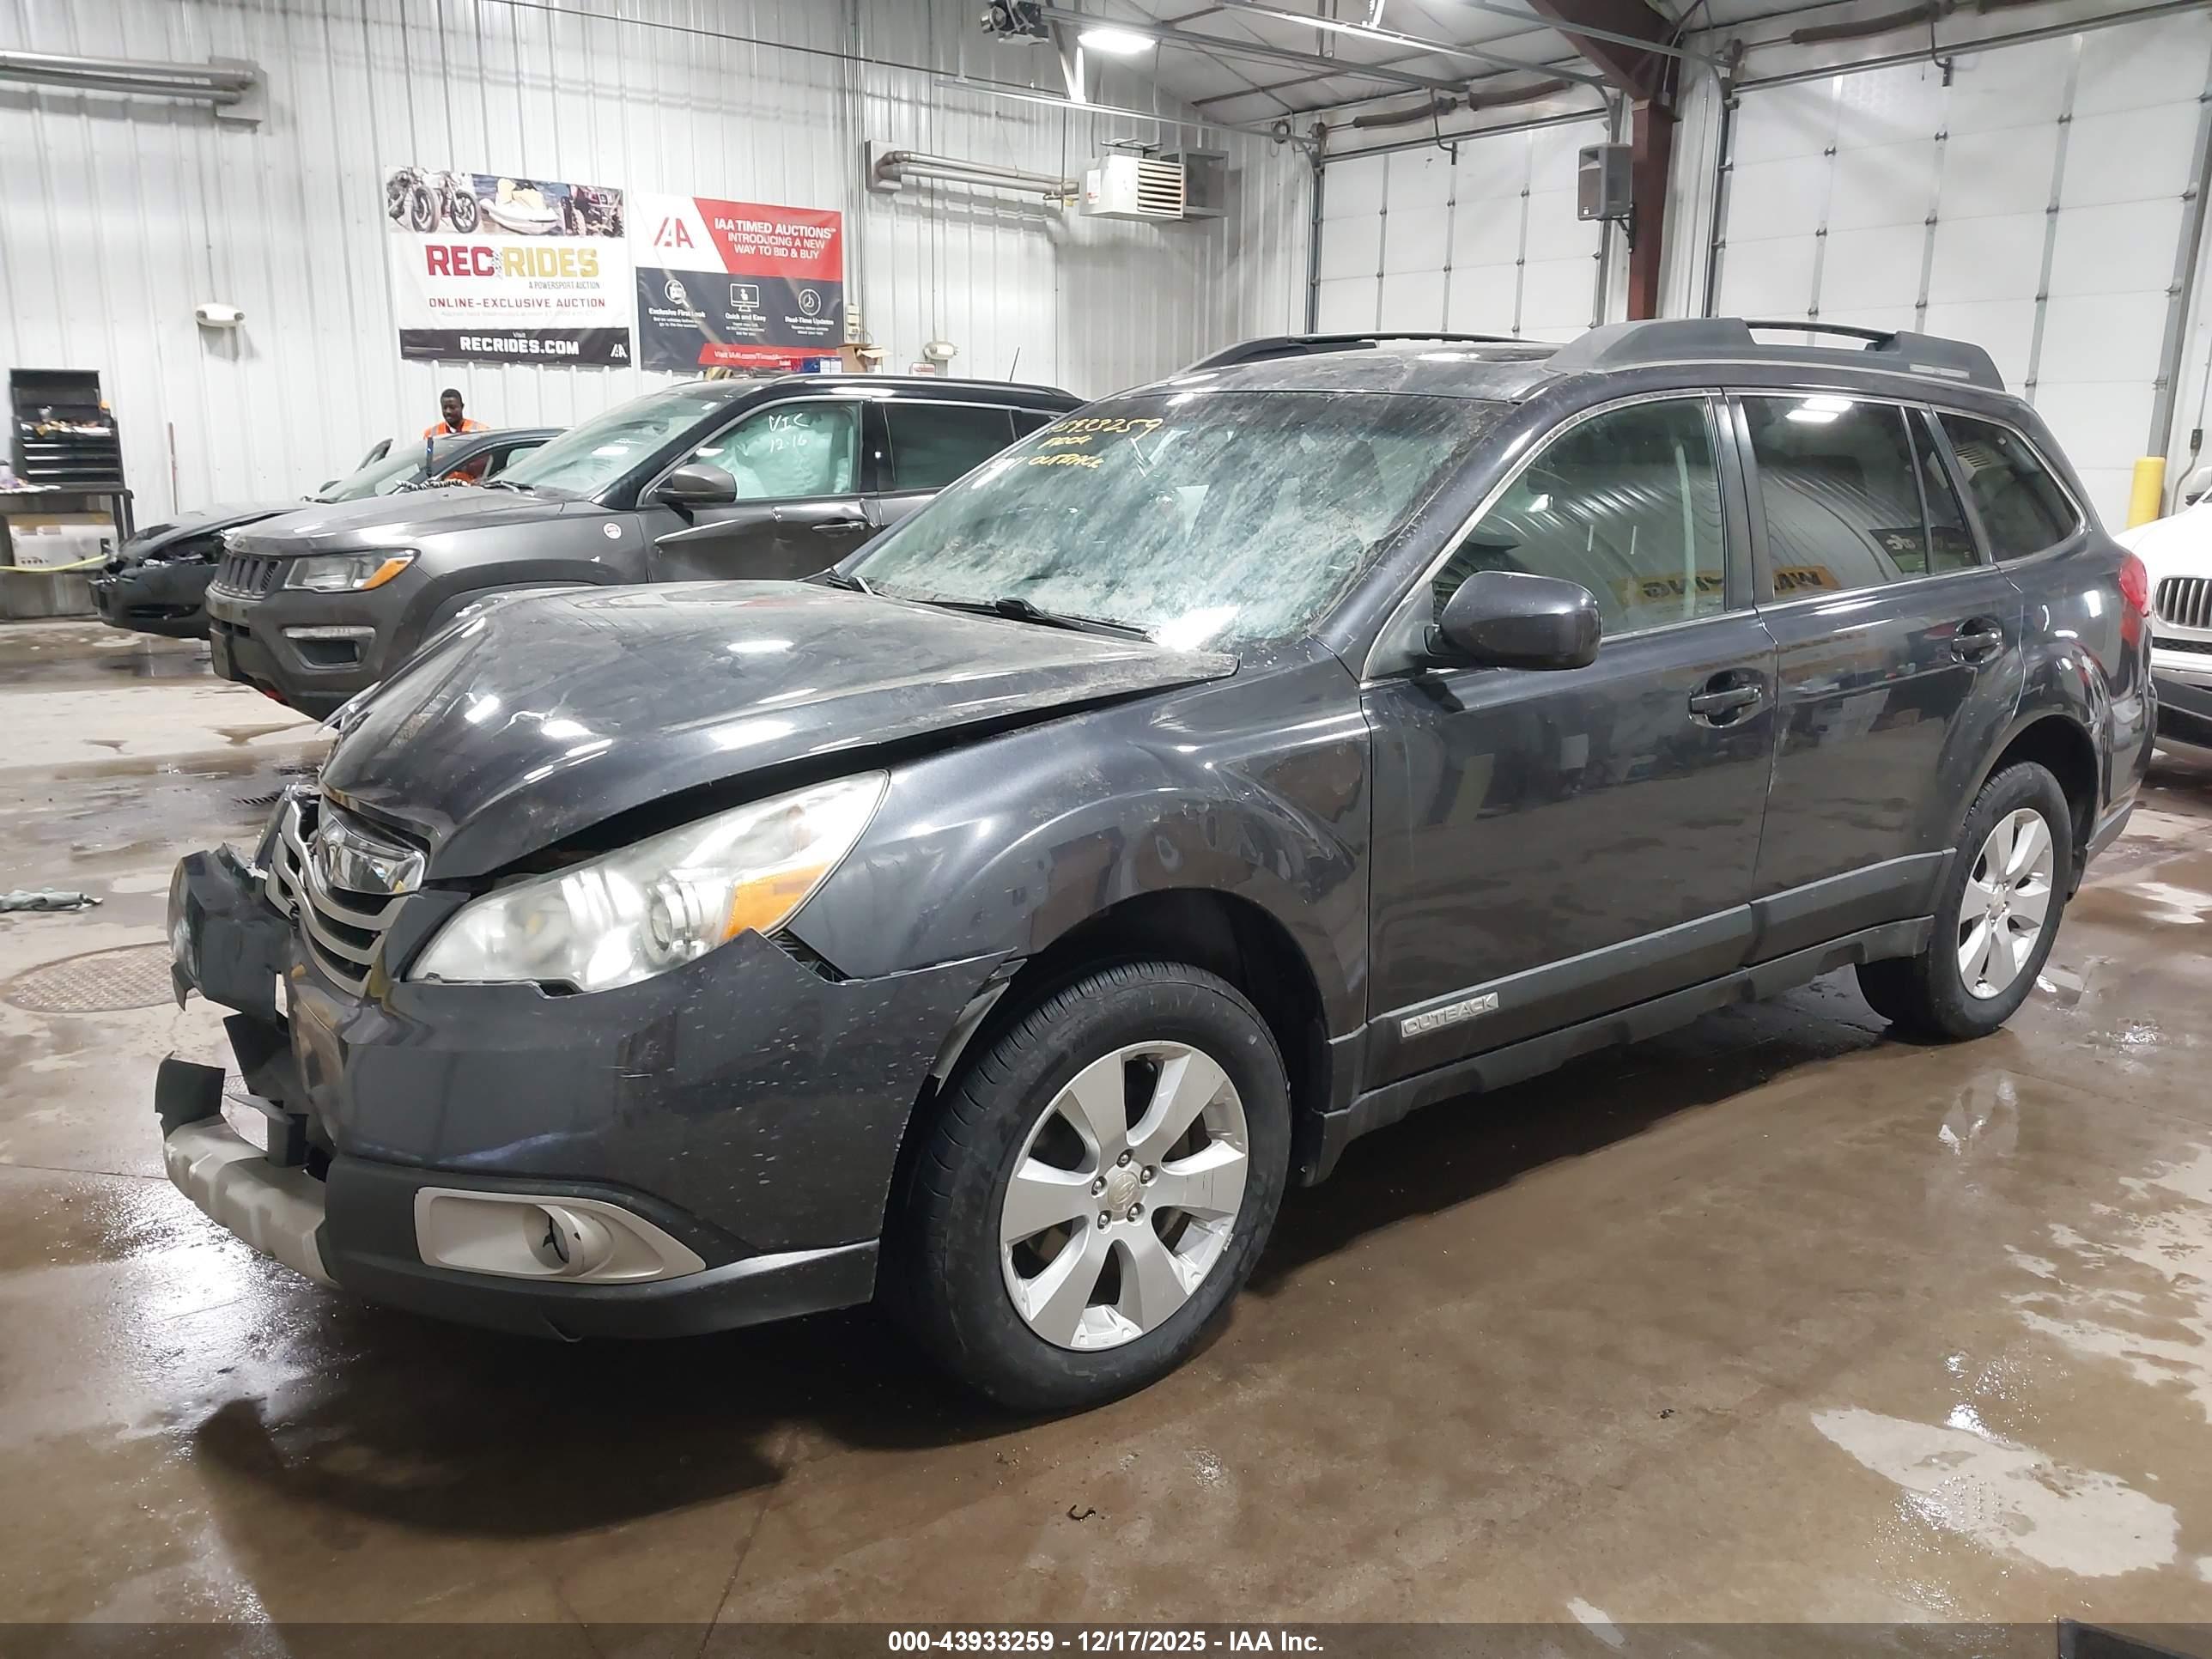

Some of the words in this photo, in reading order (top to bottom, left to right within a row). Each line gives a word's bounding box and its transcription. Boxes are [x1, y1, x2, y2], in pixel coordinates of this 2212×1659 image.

[714, 217, 733, 231] IAA
[735, 219, 772, 234] TIMED
[727, 232, 793, 246] INTRODUCING
[793, 236, 802, 246] A
[803, 237, 825, 250] NEW
[733, 244, 757, 255] WAY
[758, 245, 772, 256] TO
[774, 246, 789, 258] BID
[790, 247, 798, 258] &
[800, 248, 820, 259] BUY
[425, 245, 495, 276] REC
[502, 246, 599, 278] RIDES
[528, 281, 534, 289] A
[534, 281, 574, 289] POWERSPORT
[429, 297, 551, 308] ONLINE-EXCLUSIVE
[556, 299, 605, 308] AUCTION
[752, 313, 767, 322] Easy
[459, 336, 580, 356] RECRIDES.COM
[1403, 994, 1495, 1035] OUTBACK
